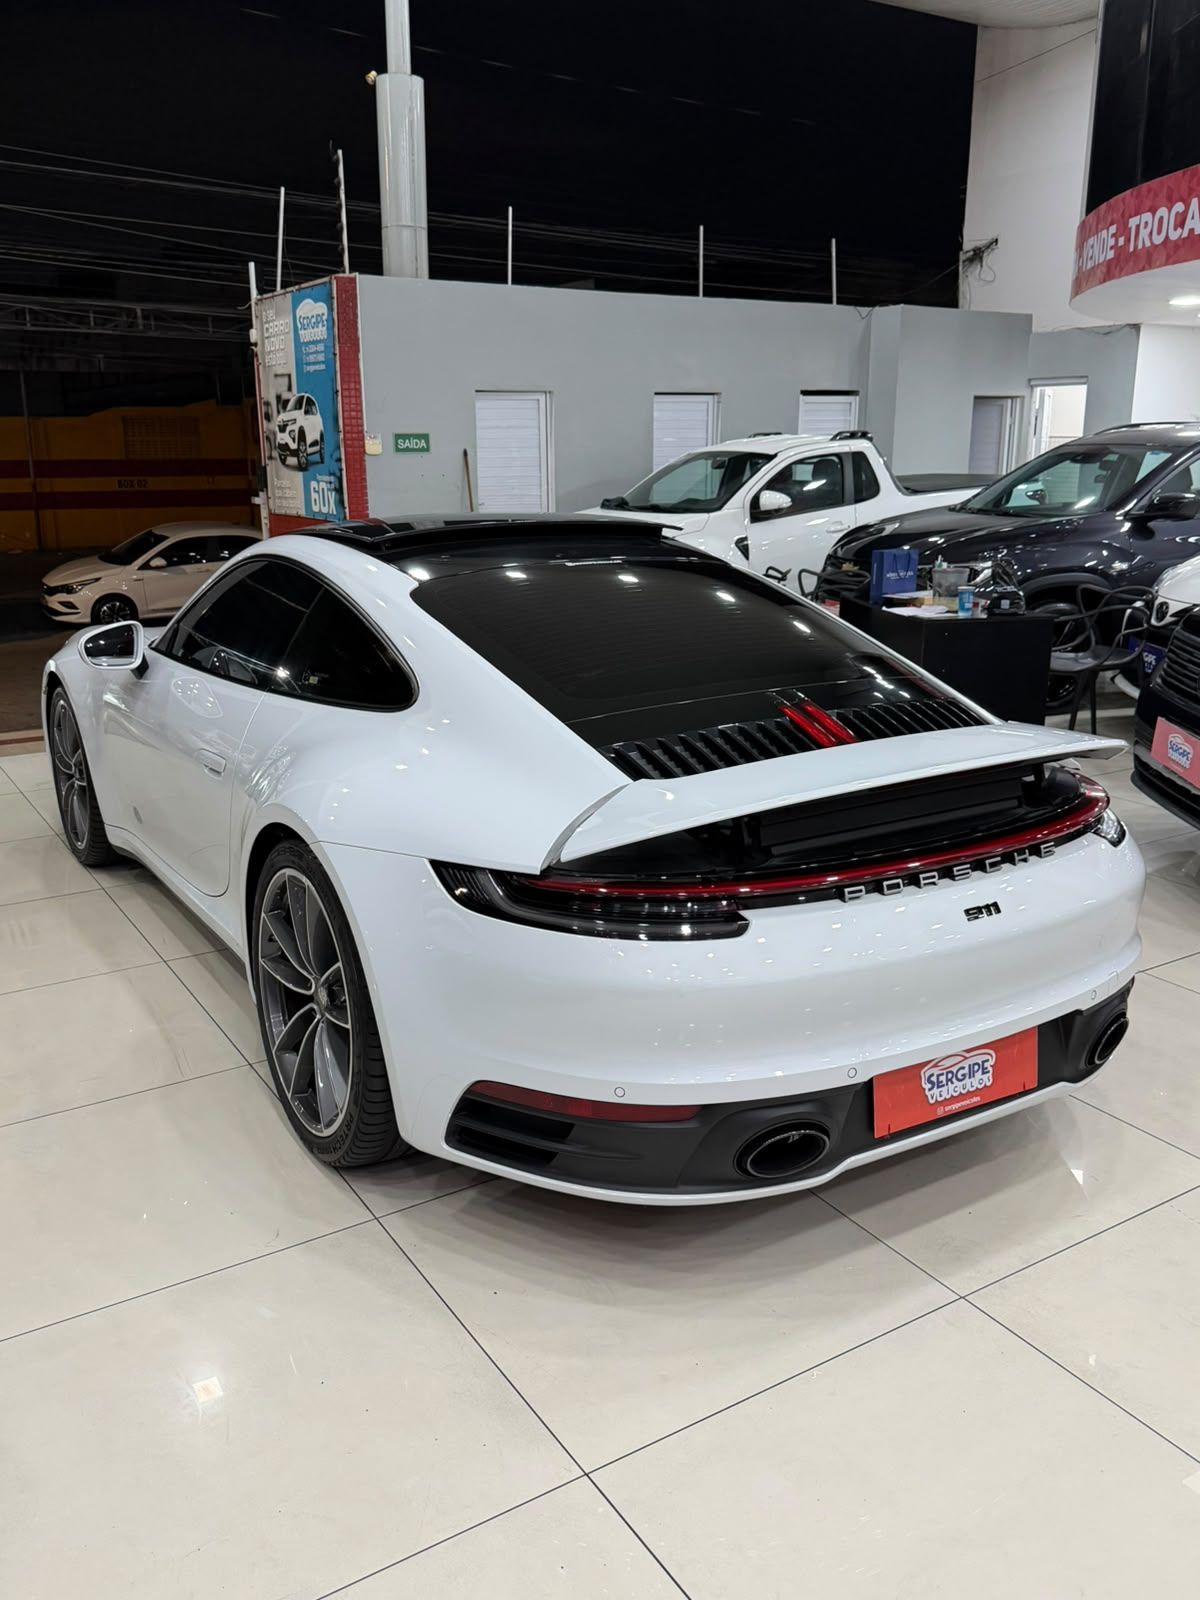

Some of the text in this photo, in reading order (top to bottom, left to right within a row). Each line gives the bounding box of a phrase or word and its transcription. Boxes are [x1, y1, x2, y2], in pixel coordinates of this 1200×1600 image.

[1083, 224, 1117, 271] VENDE
[1128, 197, 1200, 253] TROCA
[264, 319, 290, 337] CARRO
[298, 312, 327, 331] SERGIPE
[397, 437, 428, 449] SAÍDA
[843, 841, 1056, 903] PORSCHE
[963, 901, 1002, 922] 911
[926, 1058, 990, 1092] SERGIPE
